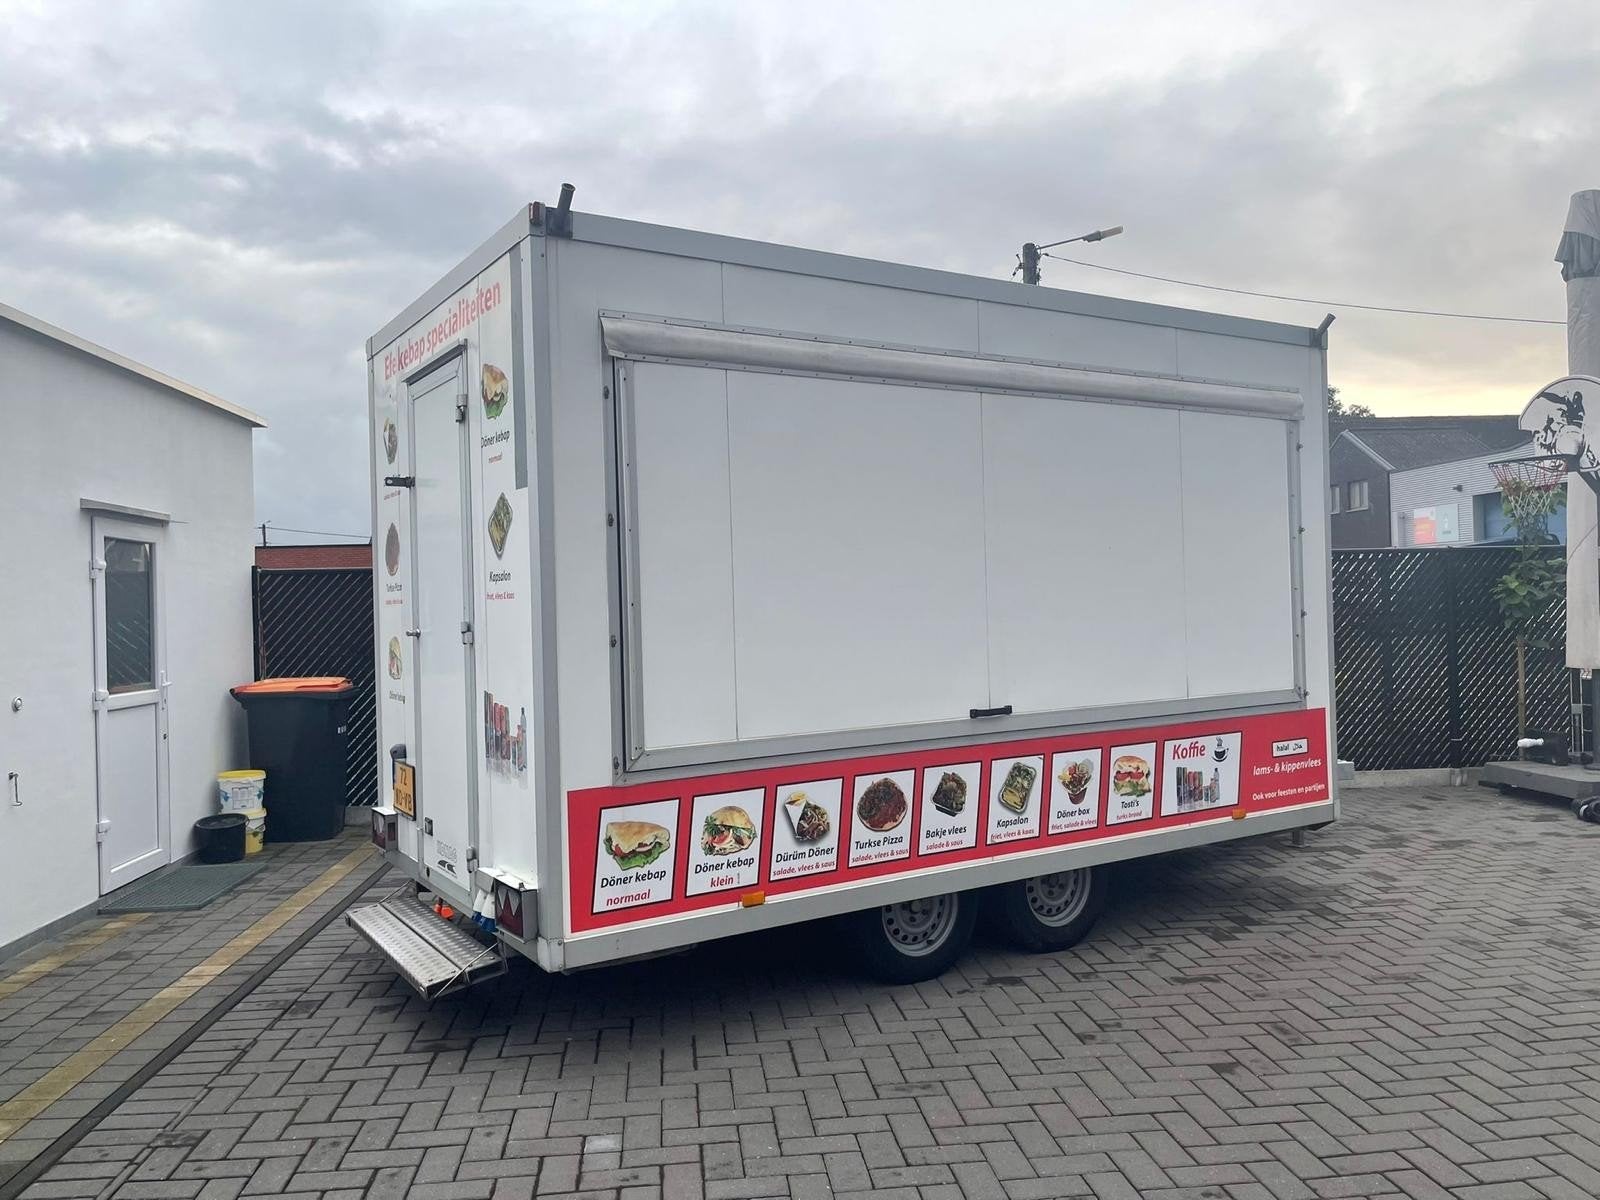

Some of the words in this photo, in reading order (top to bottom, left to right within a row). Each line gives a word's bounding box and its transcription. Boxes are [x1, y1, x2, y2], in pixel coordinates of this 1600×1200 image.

[397, 336, 426, 371] kebap
[427, 281, 502, 355] specialiteiten
[1172, 741, 1206, 760] Koffie
[1276, 743, 1290, 752] halal
[1253, 765, 1273, 776] lams-
[1274, 763, 1281, 773] &
[1280, 758, 1322, 773] kippenvlees
[1252, 791, 1265, 801] Ook
[1265, 791, 1277, 799] voor
[1278, 787, 1297, 797] feesten
[1305, 783, 1325, 794] partijen
[1121, 799, 1140, 810] Tosti's
[1056, 808, 1077, 819] Döner
[1078, 806, 1090, 816] box
[996, 815, 1029, 829] Kapsalon
[1051, 821, 1063, 831] friet,
[1063, 820, 1079, 829] salade
[1080, 819, 1084, 827] &
[1084, 818, 1097, 826] vlees
[925, 828, 947, 840] Bakje
[947, 825, 967, 836] vlees
[990, 831, 1002, 841] friet,
[1003, 829, 1016, 839] vlees
[1016, 829, 1021, 837] &
[1022, 827, 1034, 836] kaas
[855, 839, 881, 850] Turkse
[882, 835, 904, 846] Pizza
[926, 843, 943, 851] salade
[944, 841, 950, 849] &
[775, 848, 807, 864] Dürüm
[807, 845, 835, 858] Döner
[851, 853, 873, 864] salade,
[874, 850, 889, 860] vlees
[890, 849, 895, 858] &
[895, 848, 909, 856] saus
[694, 860, 724, 875] Döner
[726, 855, 755, 869] kebap
[773, 864, 797, 876] salade,
[797, 862, 814, 873] vlees
[814, 861, 820, 870] &
[821, 860, 836, 870] saus
[600, 872, 632, 889] Döner
[635, 868, 667, 882] kebap
[710, 873, 734, 888] klein
[606, 889, 651, 907] normaal
